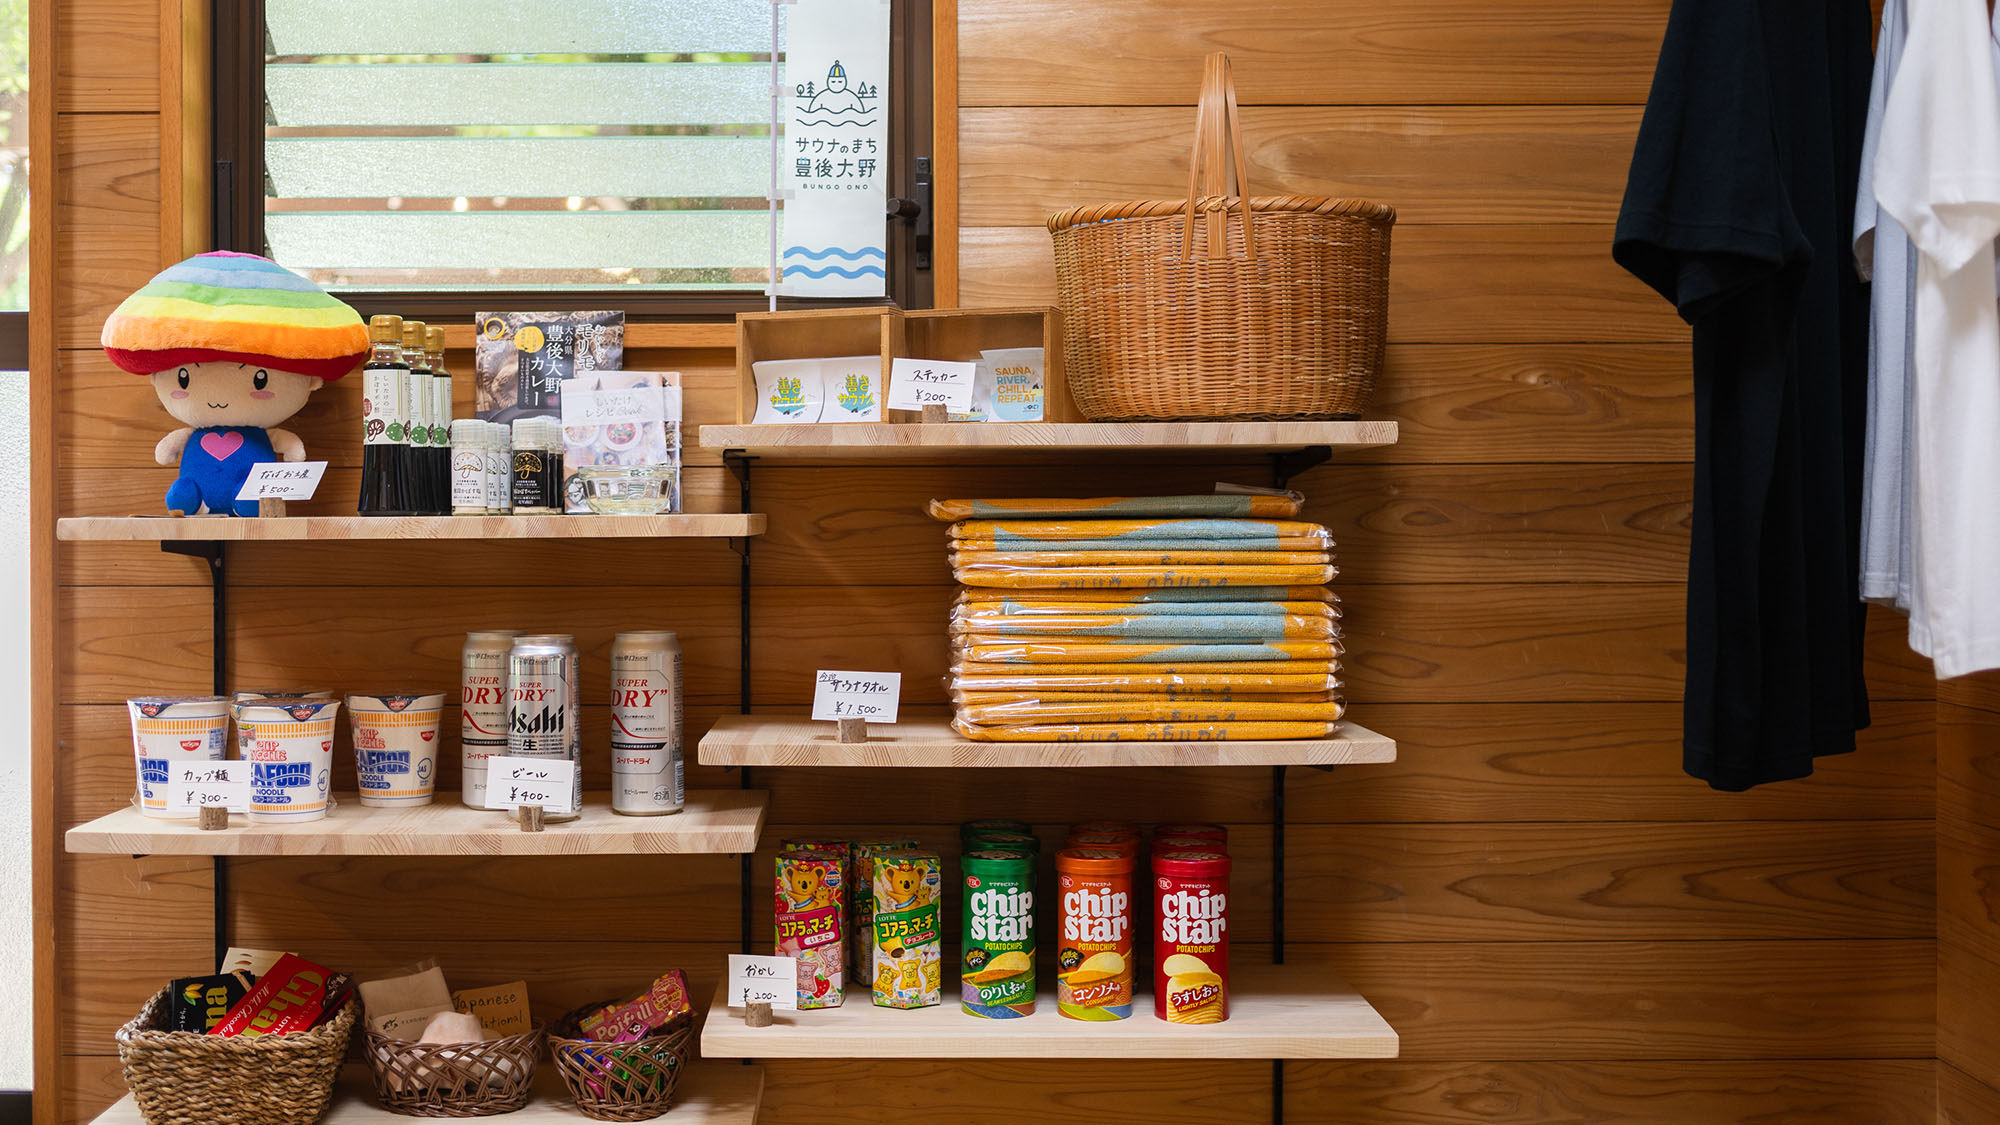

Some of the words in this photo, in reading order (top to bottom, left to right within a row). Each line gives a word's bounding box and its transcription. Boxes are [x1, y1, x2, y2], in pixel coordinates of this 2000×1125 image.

[795, 137, 877, 154] サウナのまち
[795, 157, 876, 178] 豊後大野
[564, 326, 573, 355] 大分県
[544, 324, 564, 394] 豊後大野
[530, 356, 545, 406] カレー
[913, 369, 958, 383] ステッカー
[467, 676, 499, 685] SUPER
[616, 679, 648, 687] SUPER
[830, 680, 889, 694] サウナタオル
[508, 704, 564, 734] Asahi
[522, 739, 537, 751] 生
[617, 757, 651, 765] スーパードライ
[184, 770, 230, 782] カップ麺
[512, 767, 548, 778] ビール
[653, 790, 670, 801] お酒
[970, 887, 1033, 917] chip
[1064, 887, 1127, 917] chip
[1162, 889, 1226, 919] chip
[780, 914, 835, 937] コアラのマーチ
[879, 913, 934, 938] コアラのマーチ
[970, 915, 1033, 942] star
[1064, 915, 1127, 942] star
[1162, 917, 1226, 944] star
[985, 942, 1006, 950] POTATO
[1006, 942, 1023, 950] CHIPS
[1078, 943, 1100, 951] POTATO
[1100, 943, 1117, 951] CHIPS
[1176, 945, 1198, 953] POTATO
[1198, 945, 1215, 953] CHIPS
[745, 964, 775, 977] おかし
[452, 993, 516, 1012] Japanese
